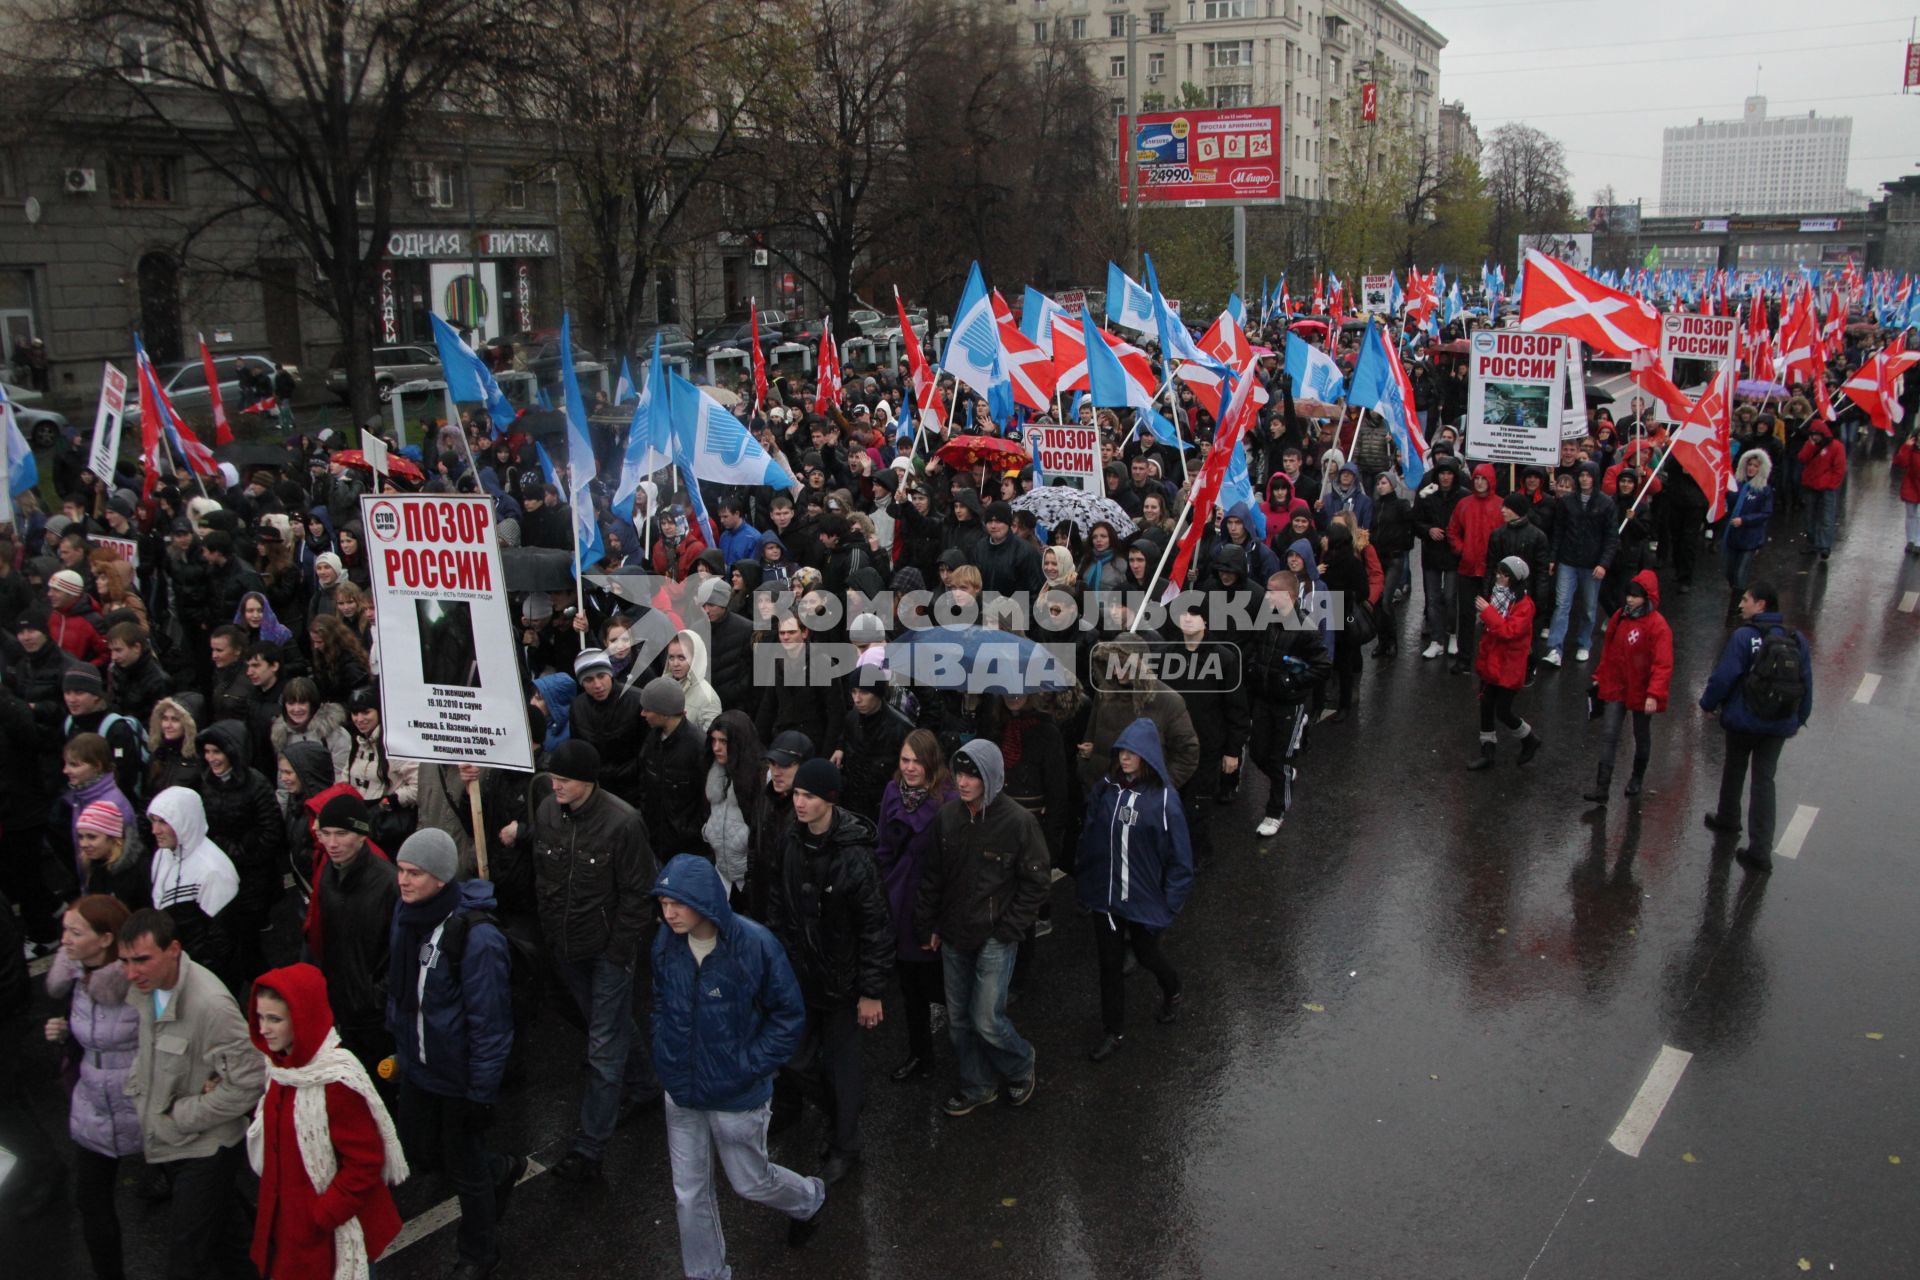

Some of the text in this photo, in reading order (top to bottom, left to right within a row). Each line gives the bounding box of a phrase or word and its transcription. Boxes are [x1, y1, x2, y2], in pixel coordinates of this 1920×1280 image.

[1203, 139, 1268, 156] 0 0 24
[383, 233, 461, 258] ОДНАЯ
[1682, 317, 1734, 337] ПОЗОР
[1496, 334, 1563, 357] ПОЗОР
[1668, 335, 1729, 356] РОССИИ
[1479, 356, 1556, 379] РОССИИ
[1044, 428, 1097, 450] ПОЗОР
[375, 512, 395, 524] СТОП
[402, 501, 489, 544] ПОЗОР
[383, 548, 492, 591] РОССИИ
[420, 589, 439, 597] наций
[432, 687, 476, 698] Эта женщина
[427, 698, 458, 709] 19.10.2010
[464, 703, 483, 711] сауне
[439, 711, 471, 722] по адресу
[446, 722, 479, 733] Казенный
[421, 732, 463, 744] предложила
[462, 736, 471, 744] за
[433, 745, 487, 756] женщину на час
